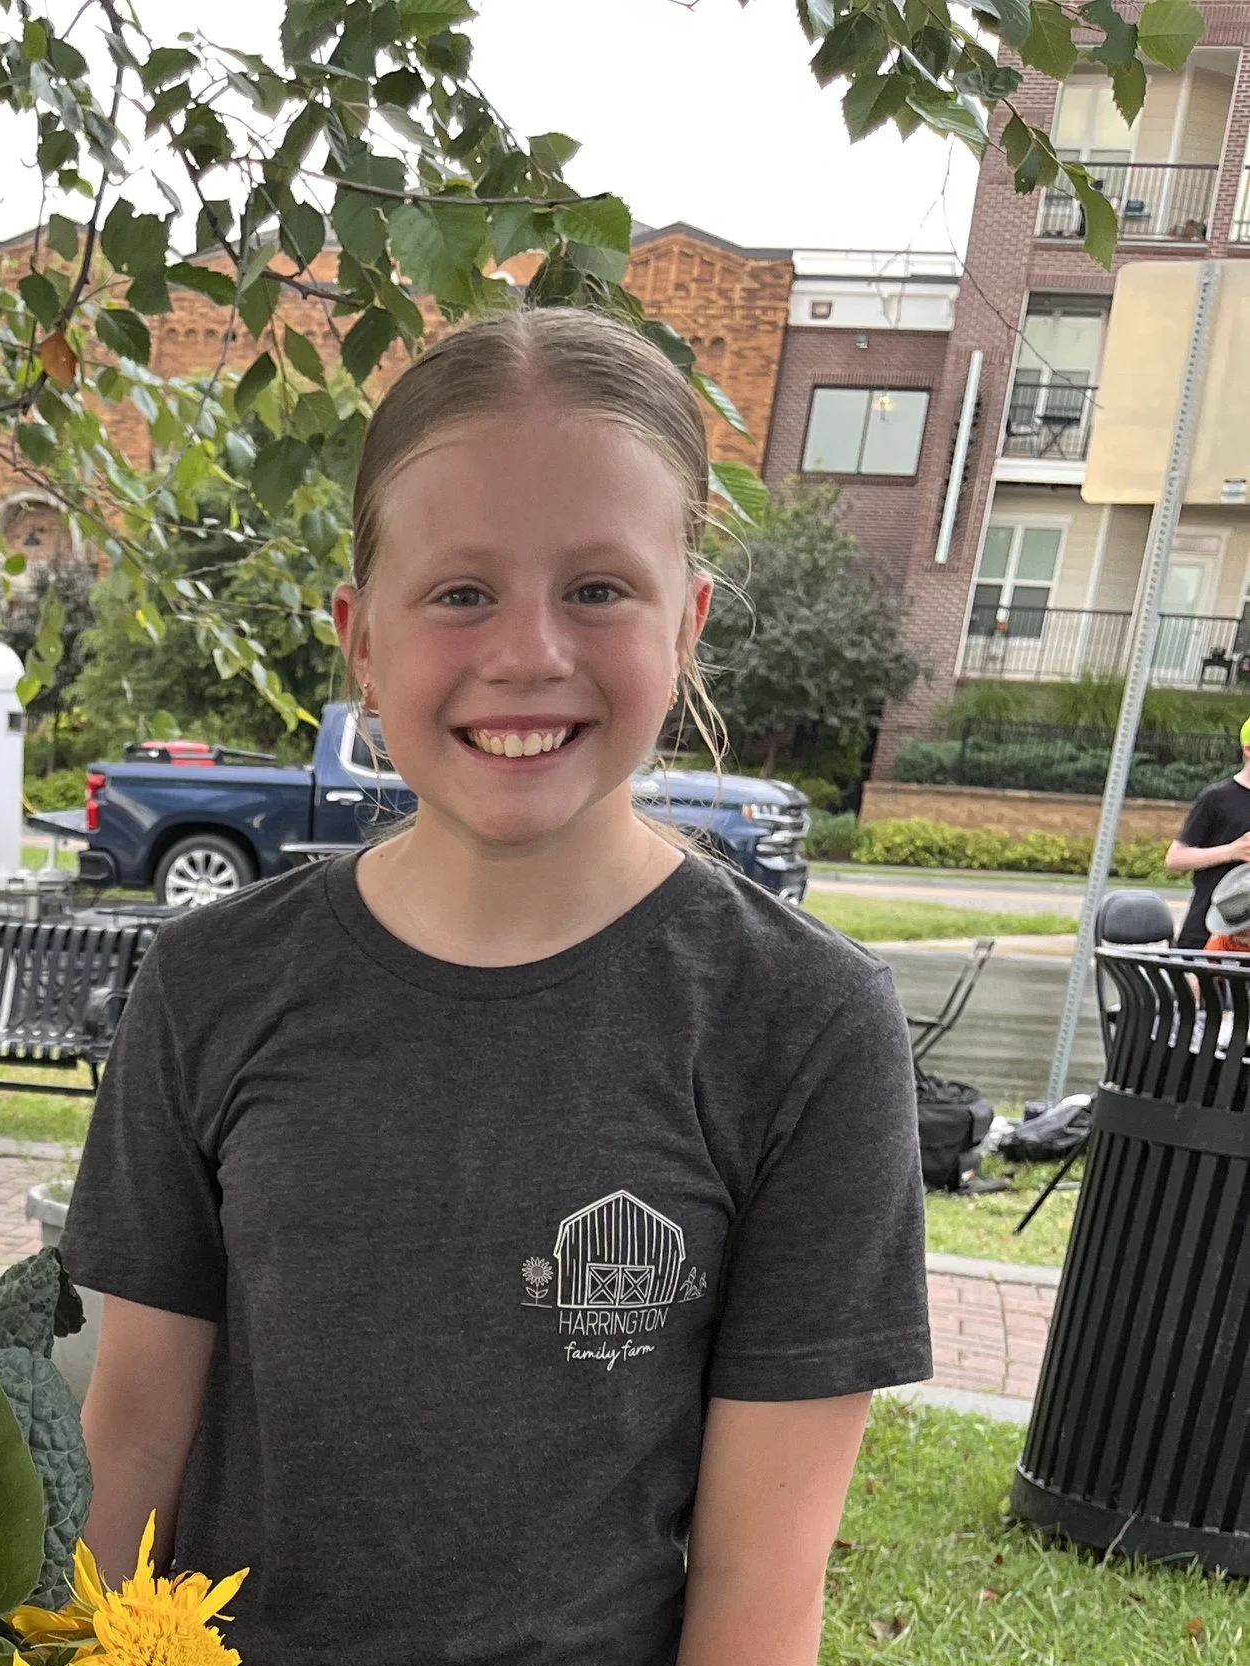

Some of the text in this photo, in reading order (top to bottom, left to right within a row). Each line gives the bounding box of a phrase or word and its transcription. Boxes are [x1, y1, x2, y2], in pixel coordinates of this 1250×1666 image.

[559, 1307, 669, 1336] HARRINGTON
[564, 1339, 654, 1371] family farm
